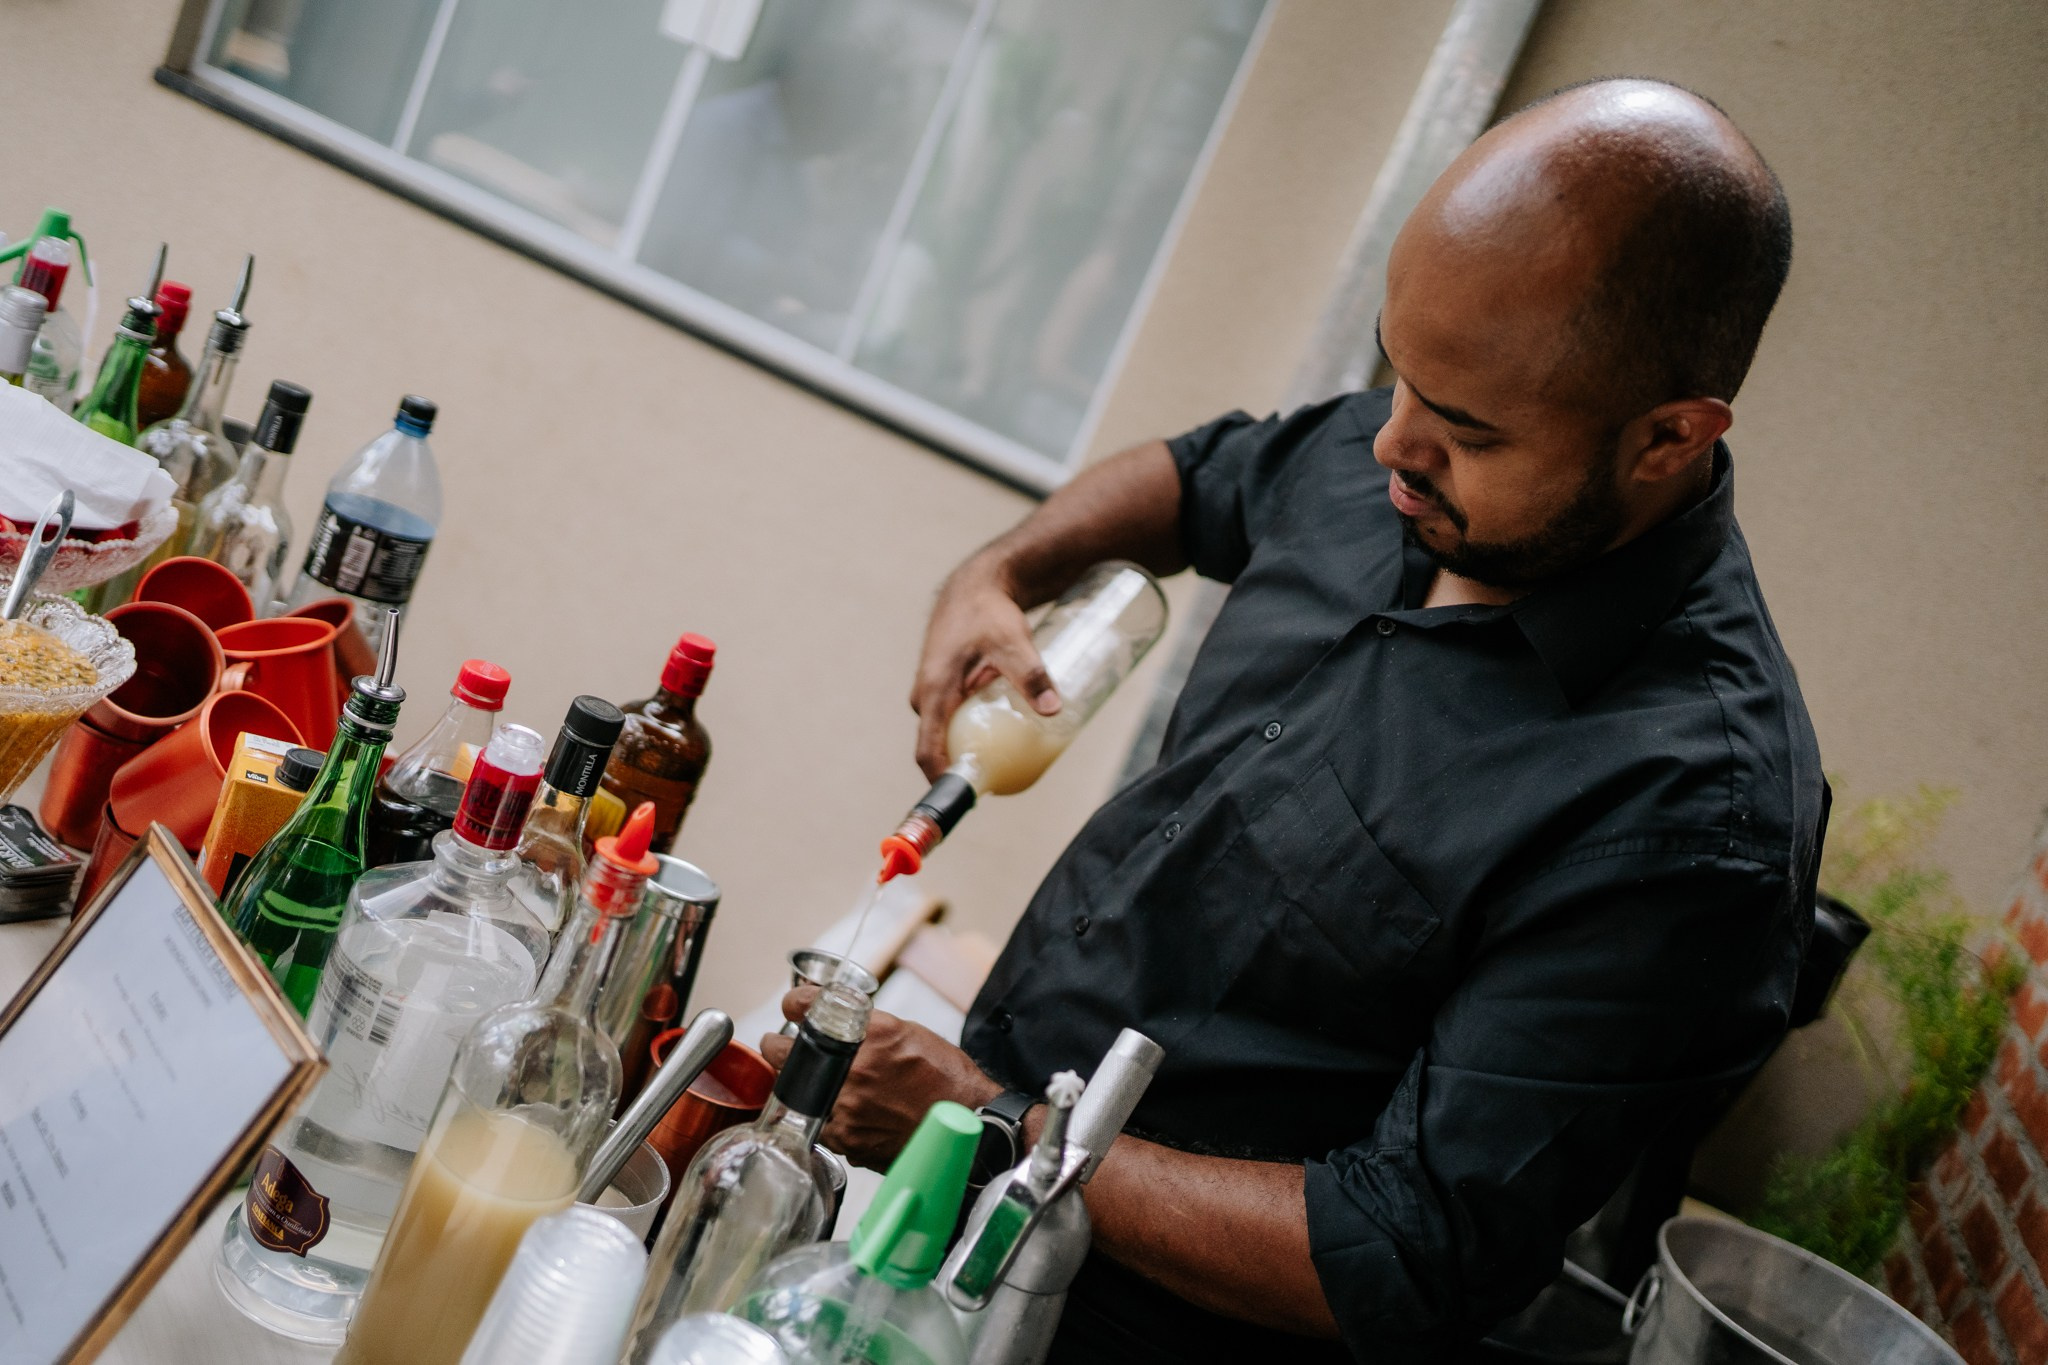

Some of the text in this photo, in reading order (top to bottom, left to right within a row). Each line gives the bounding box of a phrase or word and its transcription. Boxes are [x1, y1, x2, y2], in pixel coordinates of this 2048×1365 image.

[574, 753, 598, 795] MONTILLA
[261, 1172, 294, 1213] Adega
[280, 1216, 314, 1238] Qualidade
